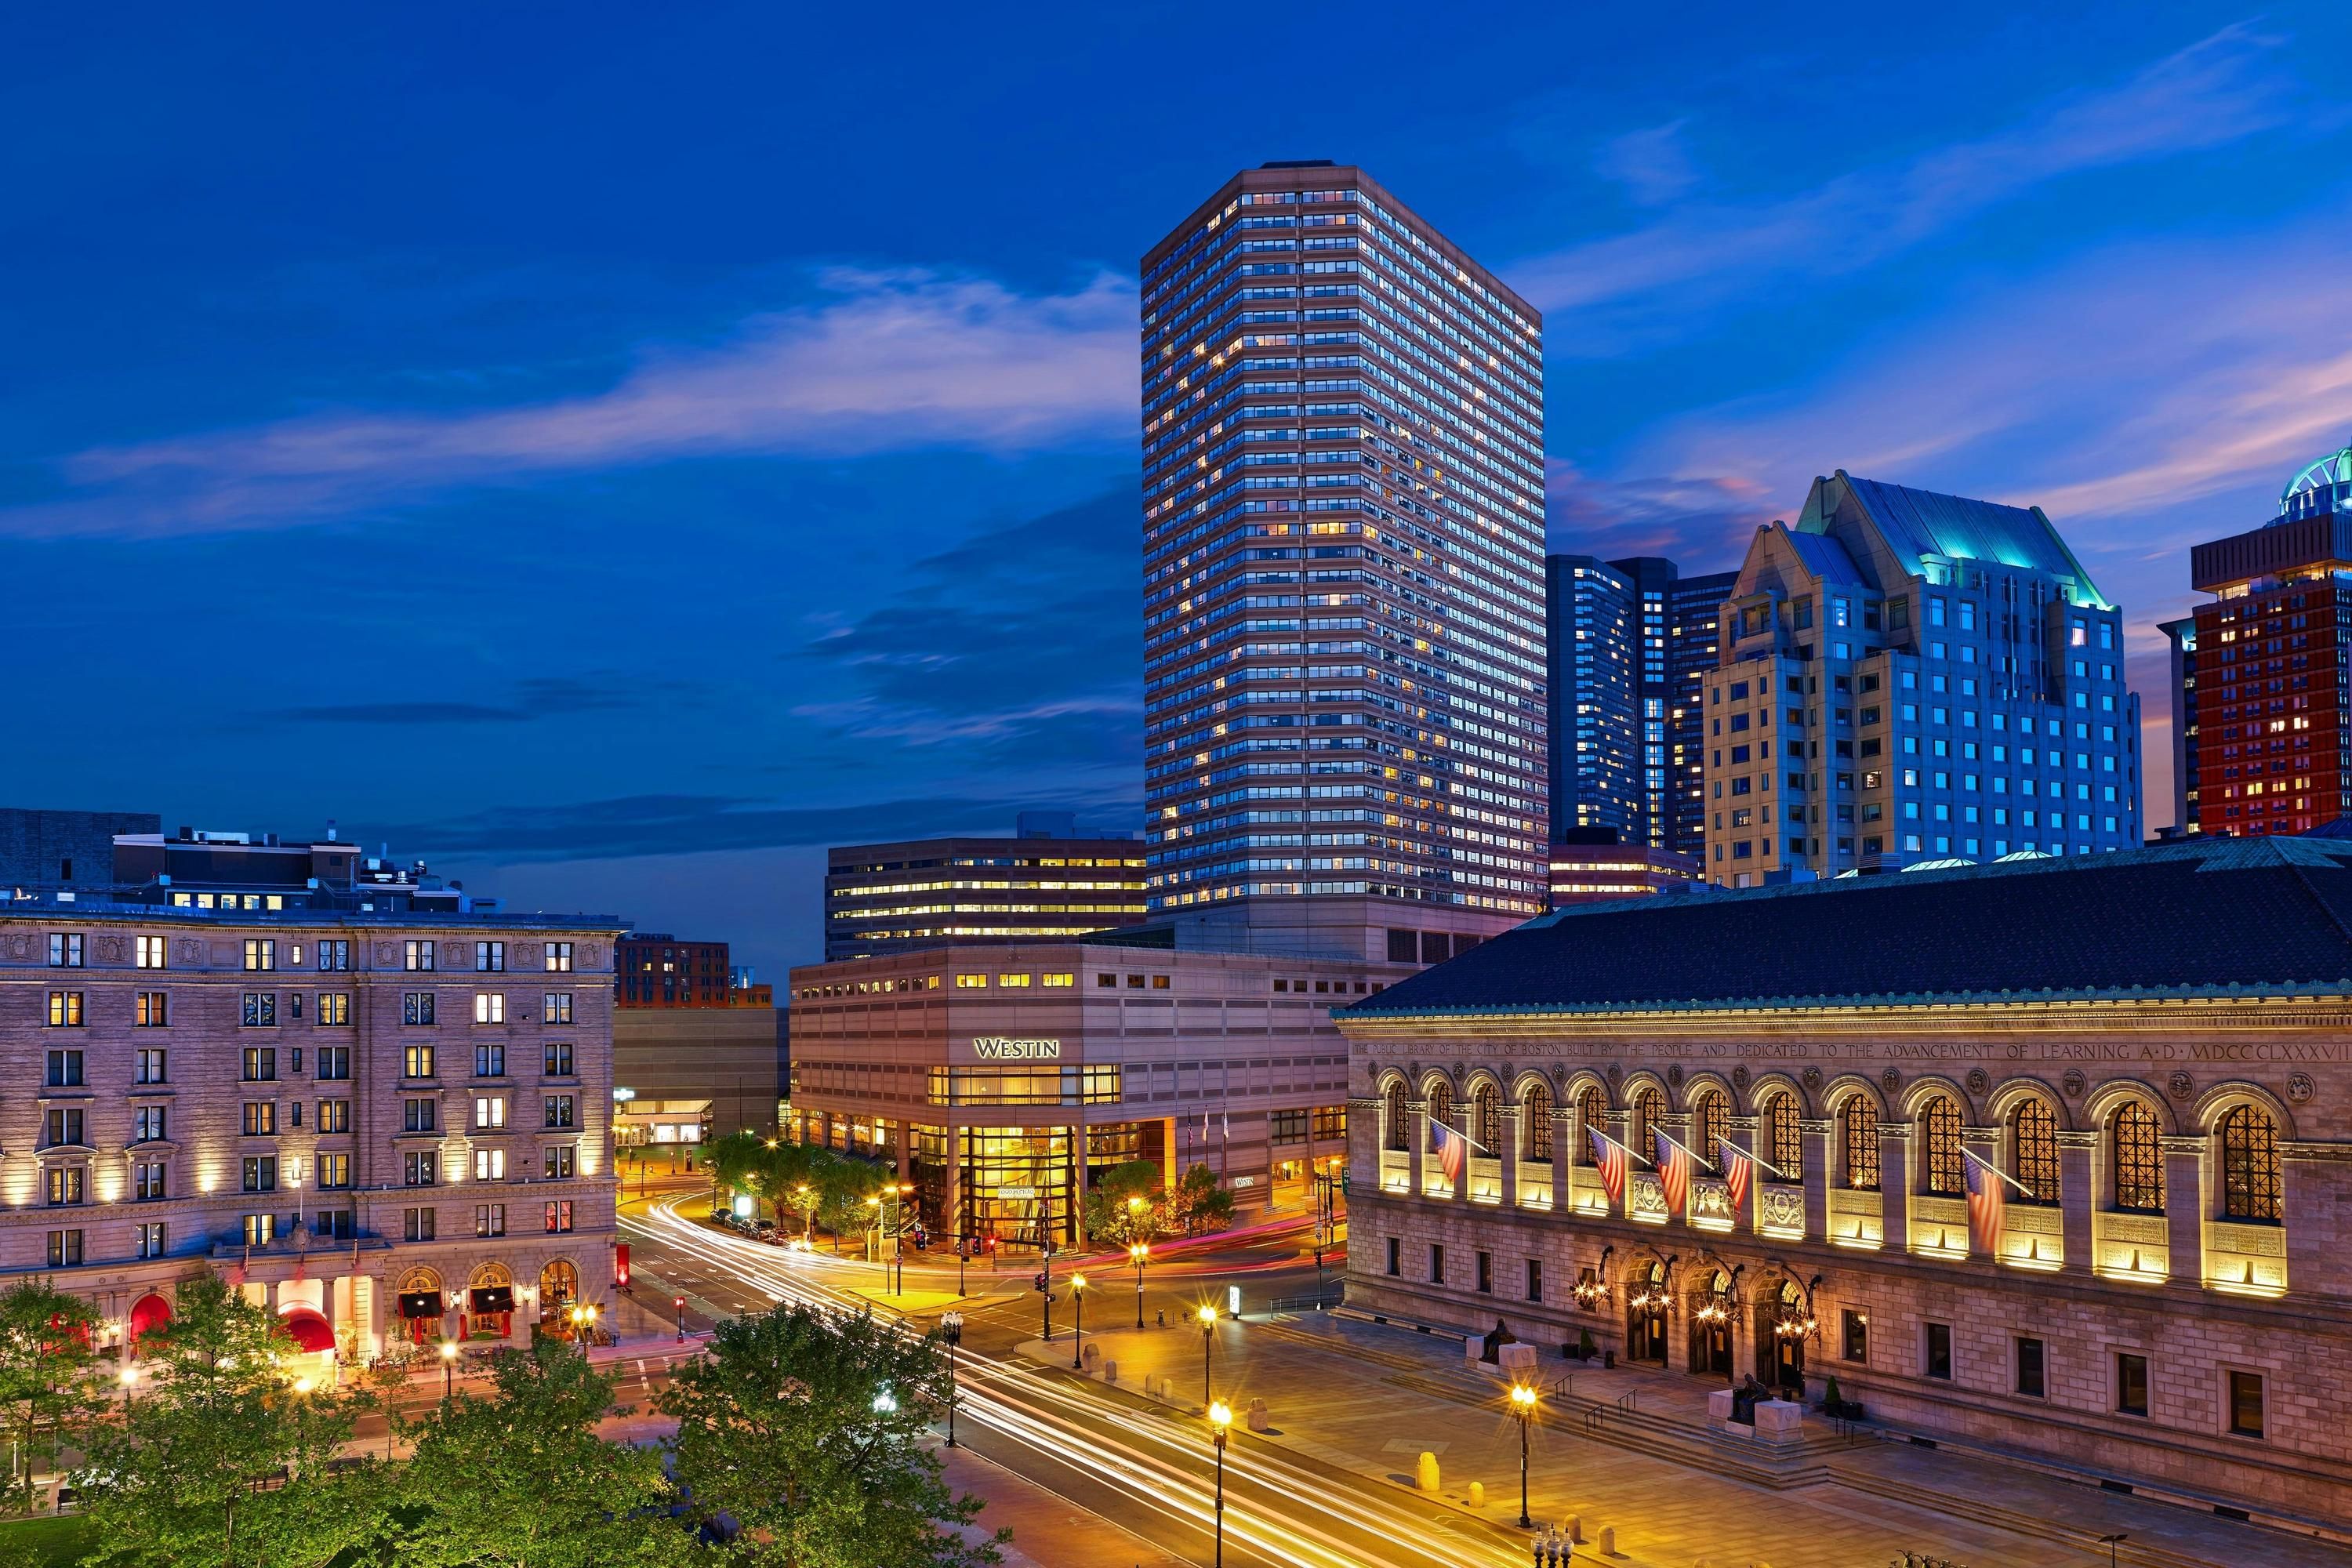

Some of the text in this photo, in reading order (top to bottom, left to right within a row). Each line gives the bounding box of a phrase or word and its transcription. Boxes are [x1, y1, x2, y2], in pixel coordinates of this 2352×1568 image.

[975, 1039, 1058, 1058] WESTIN
[1355, 1044, 1368, 1054] THE
[1403, 1044, 1435, 1054] LIBRARY
[1439, 1044, 1450, 1054] OF
[1457, 1044, 1472, 1054] THE
[1477, 1044, 1497, 1054] CITY
[1504, 1044, 1517, 1054] OF
[1522, 1044, 1561, 1054] BOSTON
[1568, 1044, 1594, 1055] BUILT
[1601, 1044, 1614, 1055] BY
[1622, 1044, 1645, 1055] THE
[1652, 1044, 1693, 1056] PEOPLE
[1702, 1044, 1726, 1056] AND
[1737, 1044, 1807, 1057] DEDICATED
[1819, 1044, 1837, 1057] TO
[1846, 1044, 1875, 1058] THE
[1883, 1044, 1994, 1058] ADVANCEMENT
[2006, 1044, 2028, 1058] OF
[2042, 1044, 2129, 1059] LEARNING
